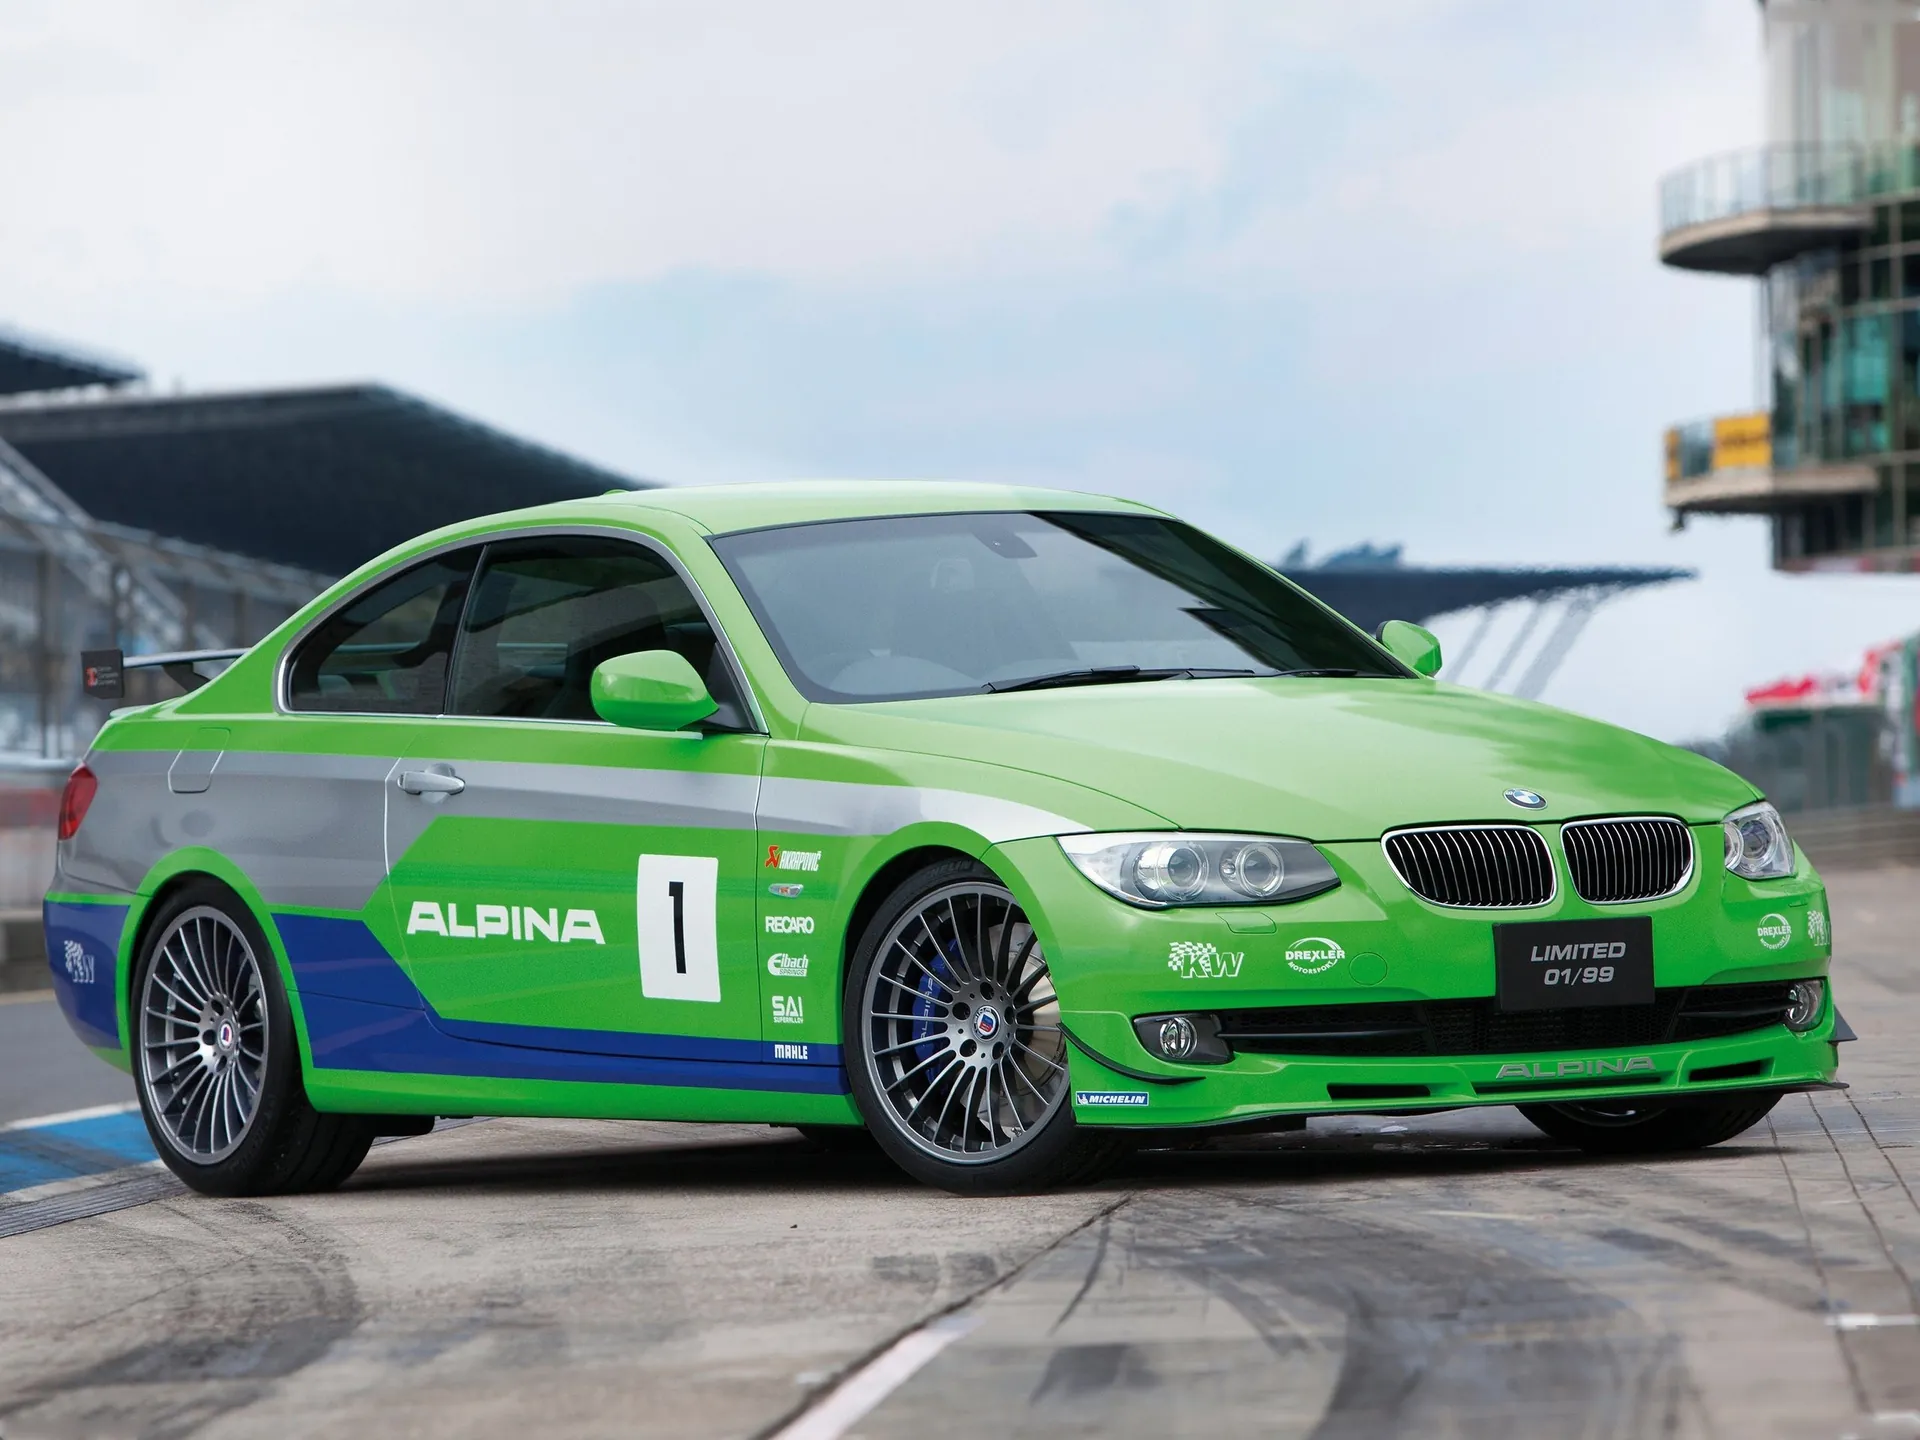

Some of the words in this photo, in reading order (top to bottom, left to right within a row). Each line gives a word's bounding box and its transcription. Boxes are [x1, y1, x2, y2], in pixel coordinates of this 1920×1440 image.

[407, 901, 606, 944] ALPINA
[668, 881, 687, 974] 1
[765, 916, 815, 934] RECARO
[1757, 925, 1792, 938] DREXLER
[1285, 950, 1345, 962] DREXLER
[1530, 942, 1627, 962] LIMITED
[767, 953, 809, 972] Eibach
[1181, 952, 1245, 979] KW
[1288, 960, 1335, 975] MOTORSPORT
[1543, 966, 1615, 986] 01/99
[771, 995, 804, 1017] SAI
[774, 1044, 808, 1060] MAHLE
[1496, 1056, 1657, 1079] ALPINA
[1088, 1095, 1146, 1104] MICHELIN
